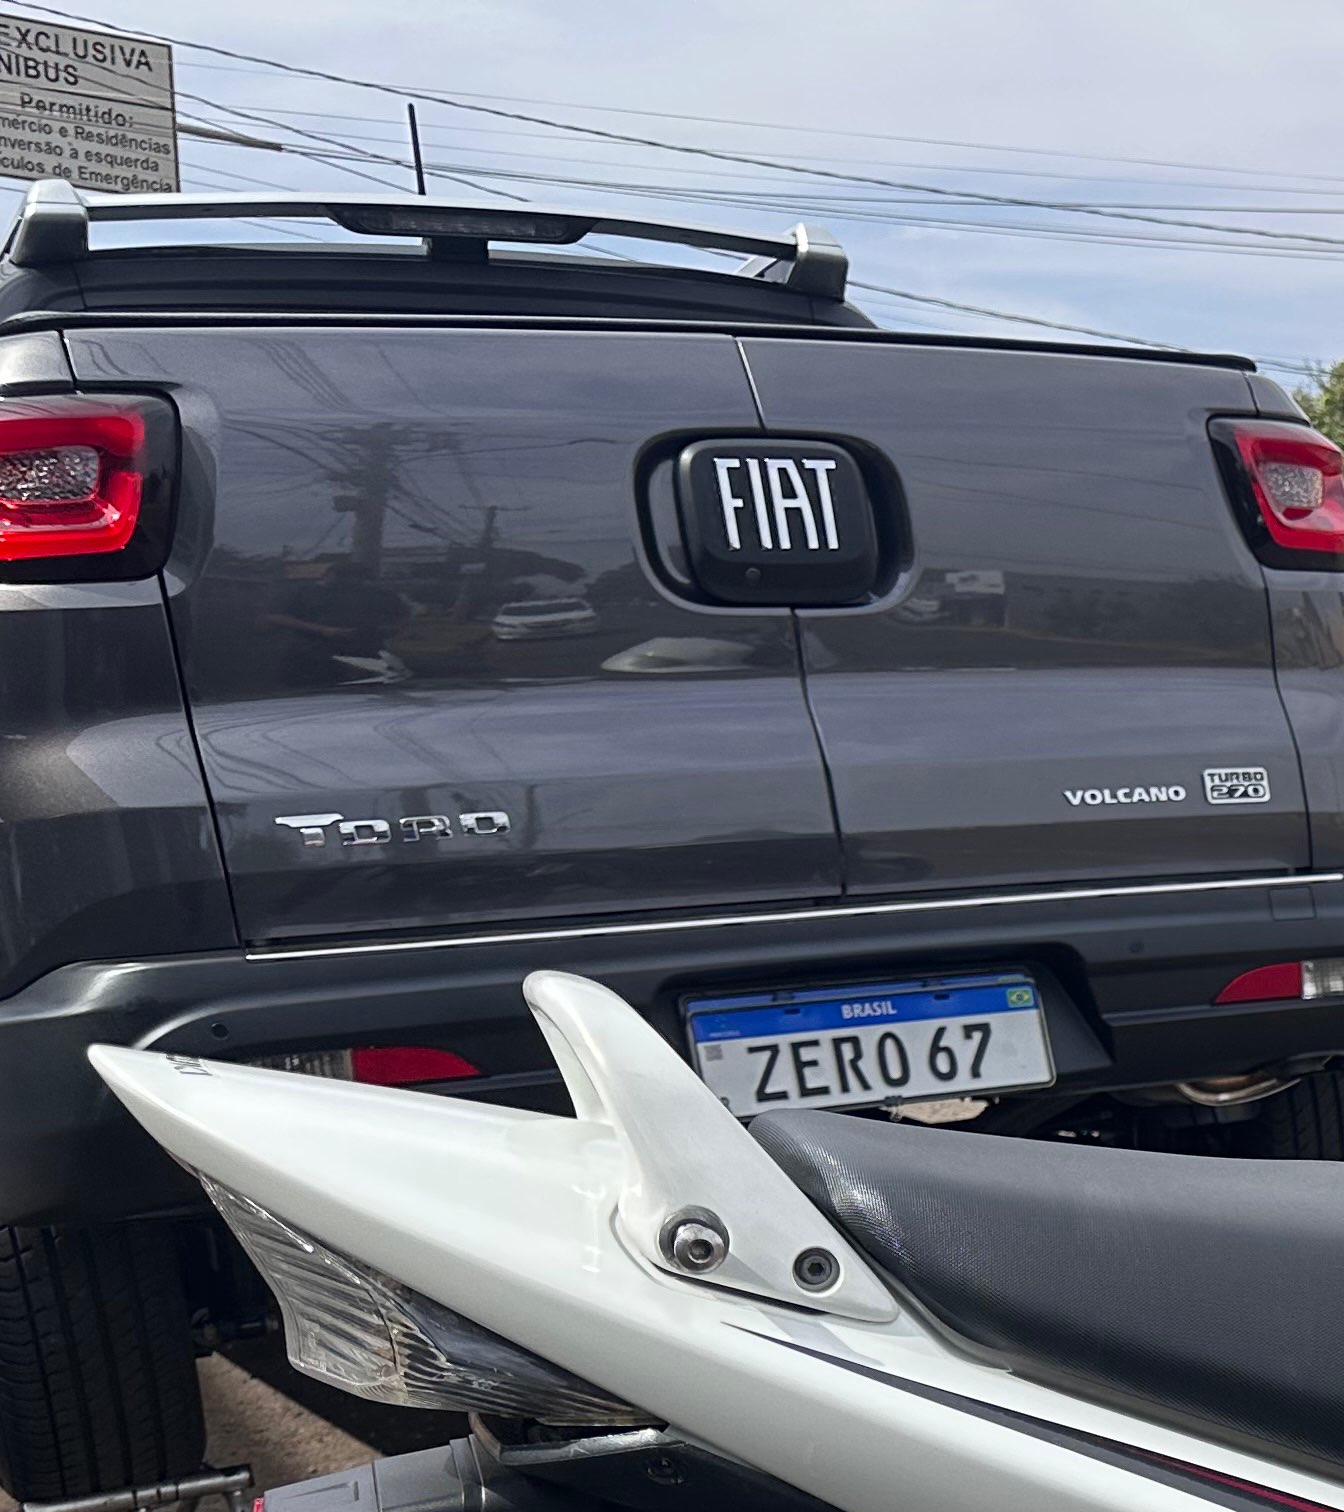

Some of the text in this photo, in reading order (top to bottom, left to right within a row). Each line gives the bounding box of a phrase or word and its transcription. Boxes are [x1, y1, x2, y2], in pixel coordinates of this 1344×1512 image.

[59, 126, 69, 138] e
[75, 125, 171, 156] Residências
[85, 150, 159, 173] esquerda
[0, 156, 173, 193] culos de Emergência
[713, 457, 840, 551] FIAT
[1207, 771, 1265, 783] TURBO
[1063, 785, 1187, 806] VOLCANO
[1211, 784, 1264, 799] 270
[841, 1001, 897, 1020] BRASIL
[747, 1021, 992, 1103] ZERO 67
